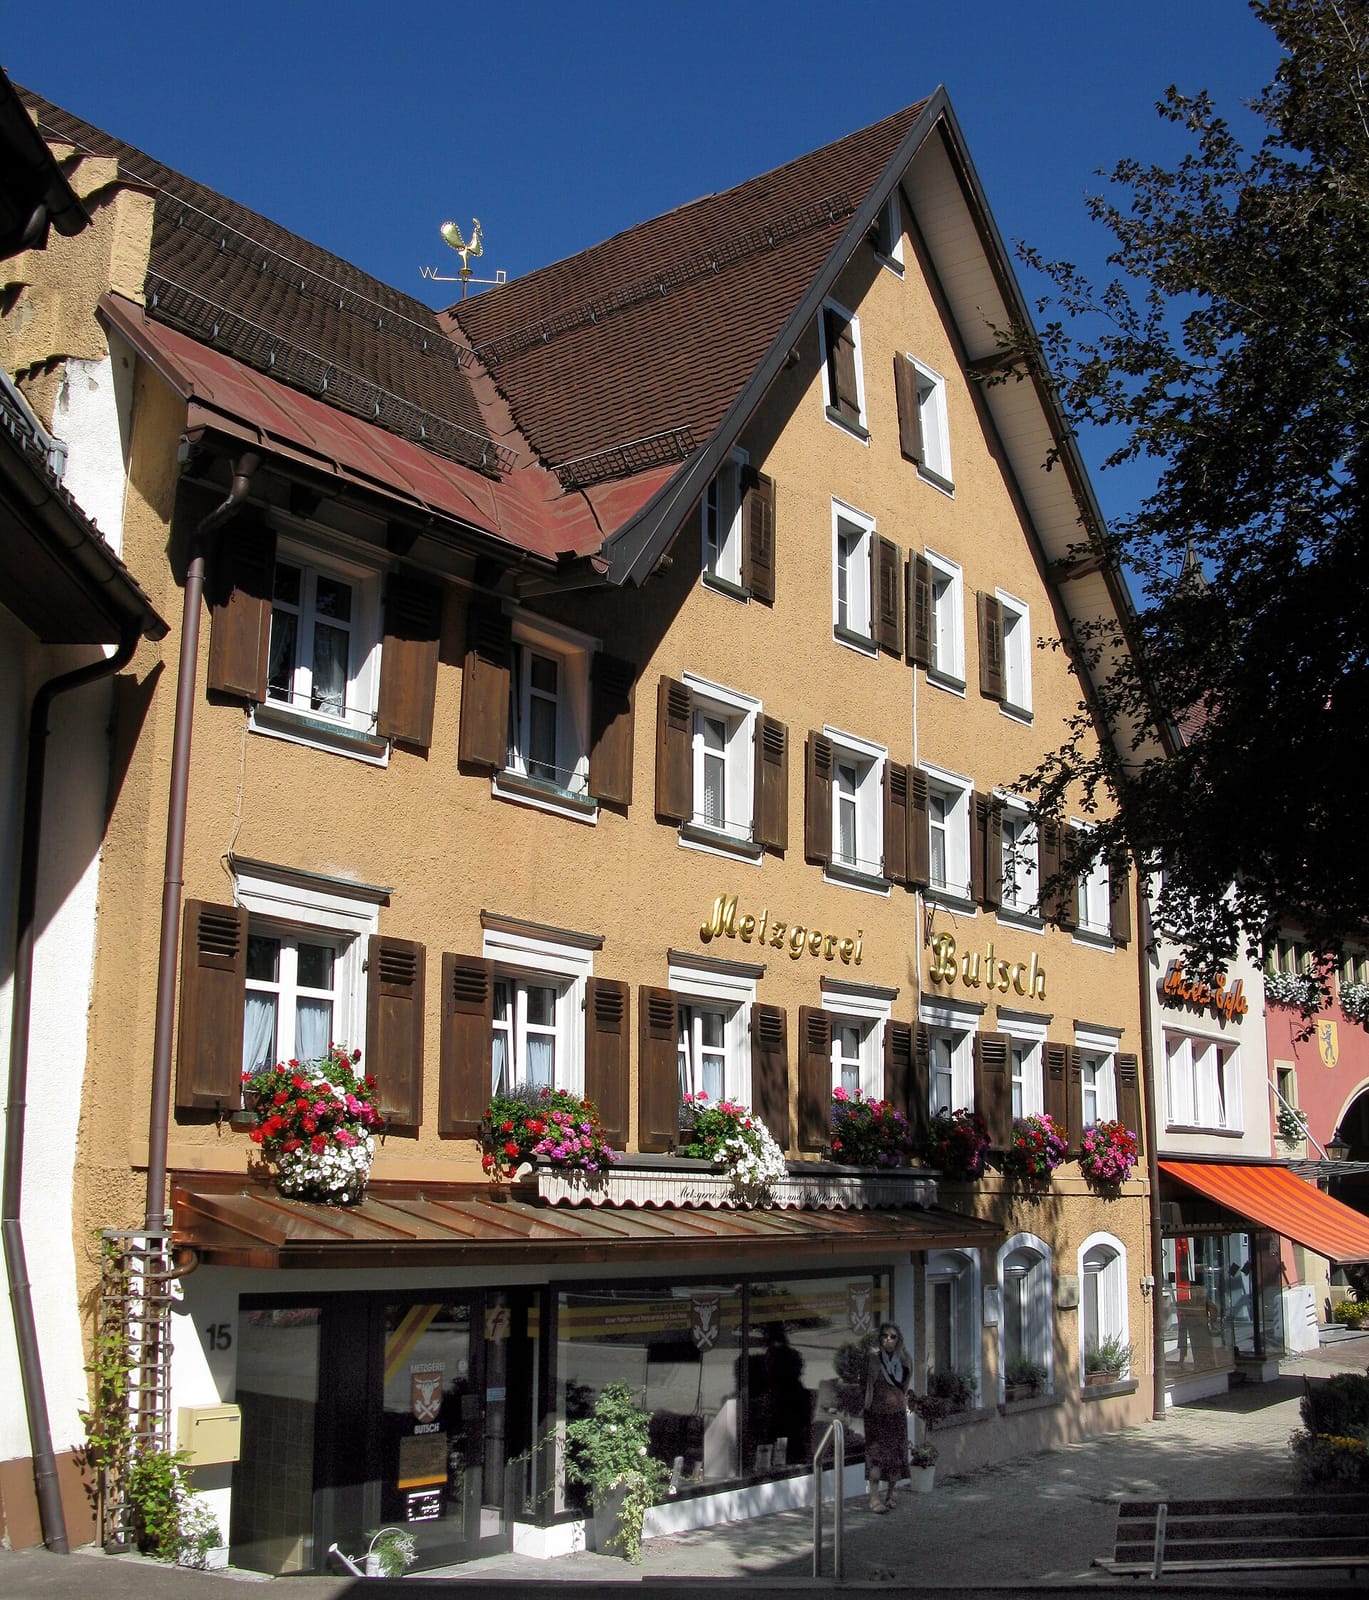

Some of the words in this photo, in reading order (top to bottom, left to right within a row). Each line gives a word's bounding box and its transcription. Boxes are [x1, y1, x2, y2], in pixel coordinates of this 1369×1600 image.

[699, 892, 864, 965] Metzgerei
[929, 931, 1047, 1000] Butsch
[205, 1323, 232, 1351] 15
[413, 1422, 441, 1435] BUTSCH
